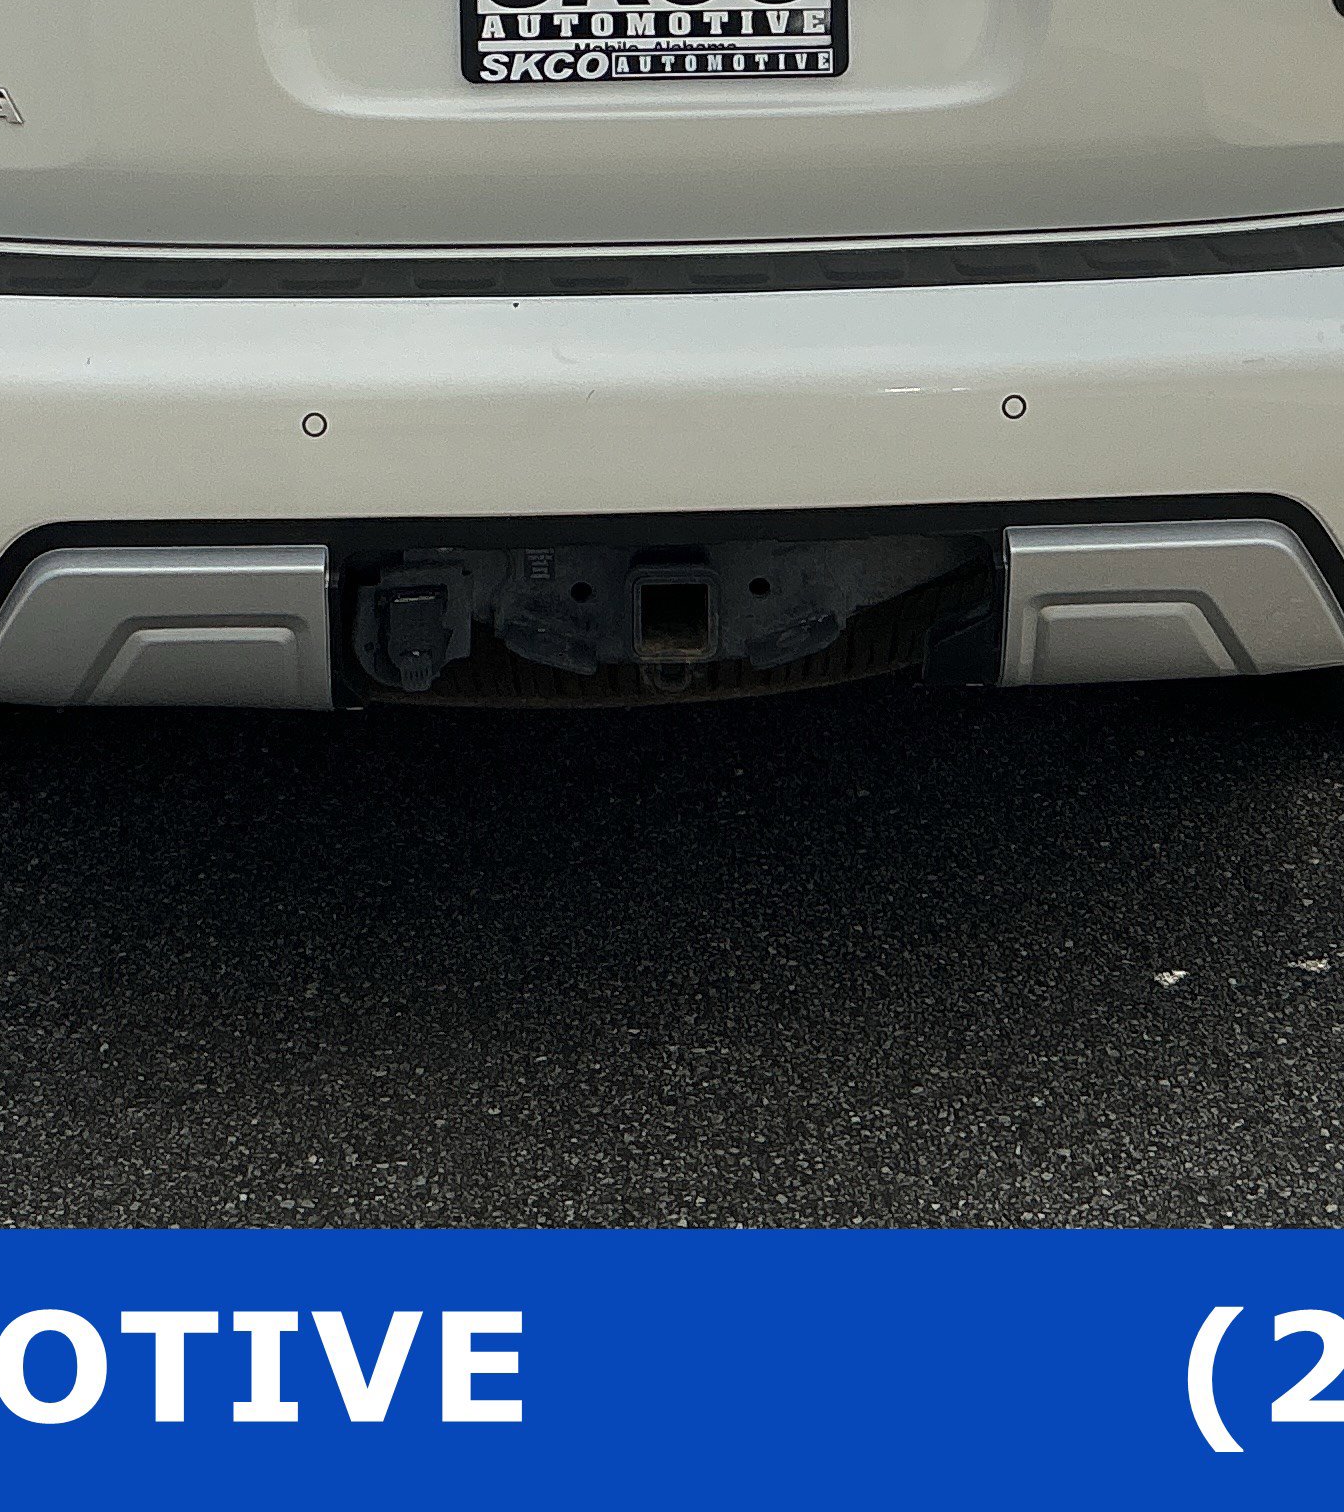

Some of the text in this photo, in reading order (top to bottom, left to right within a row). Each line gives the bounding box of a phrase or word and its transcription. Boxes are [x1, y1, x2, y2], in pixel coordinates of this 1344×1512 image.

[481, 9, 826, 39] AUTOMOTIVE
[479, 50, 830, 82] SKCO AUTOMOTIVE
